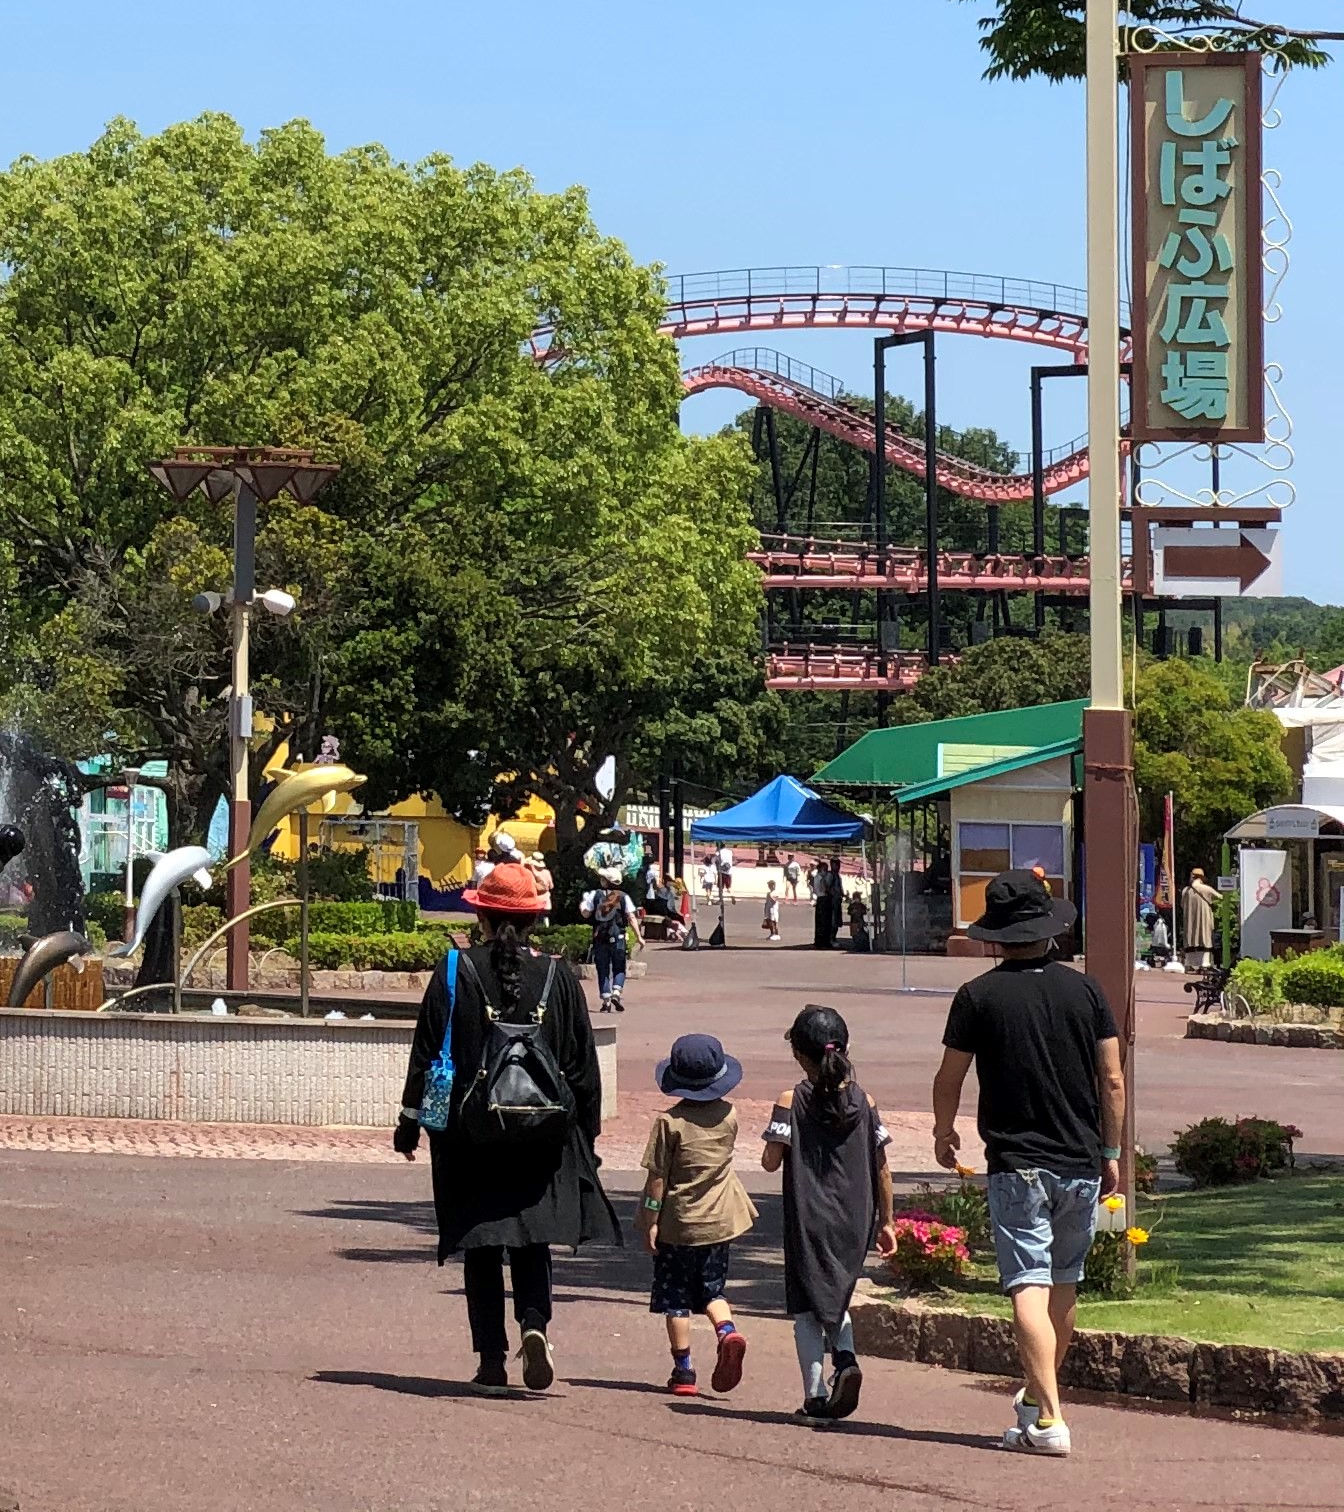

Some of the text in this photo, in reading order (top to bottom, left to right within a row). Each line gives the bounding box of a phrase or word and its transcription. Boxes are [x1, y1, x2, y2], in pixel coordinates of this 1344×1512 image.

[1160, 71, 1239, 420] しばふ広場
